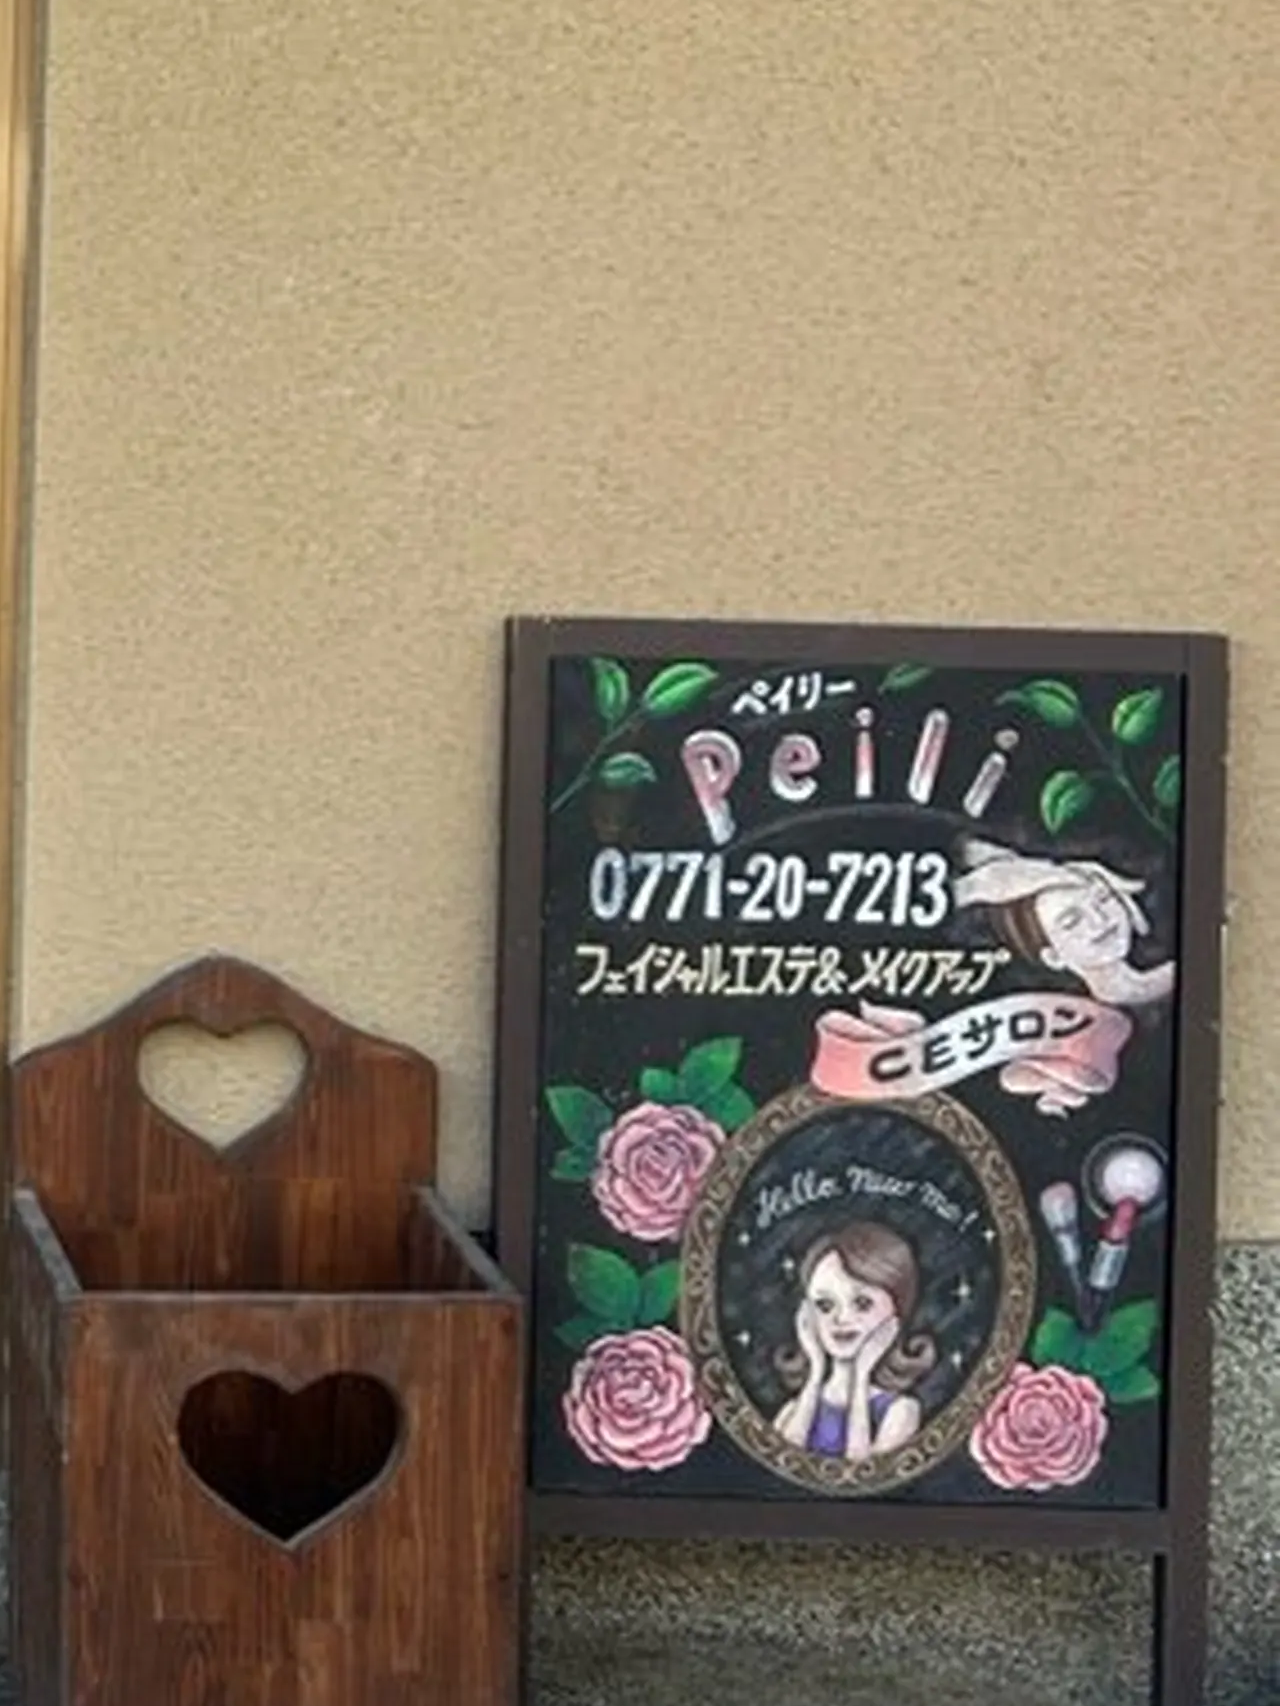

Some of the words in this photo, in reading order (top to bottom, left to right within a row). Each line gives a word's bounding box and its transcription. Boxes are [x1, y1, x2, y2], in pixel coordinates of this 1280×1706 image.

[733, 672, 855, 716] ペイリー
[590, 851, 948, 927] 0771-20-7213
[868, 1007, 1094, 1084] CEサロン
